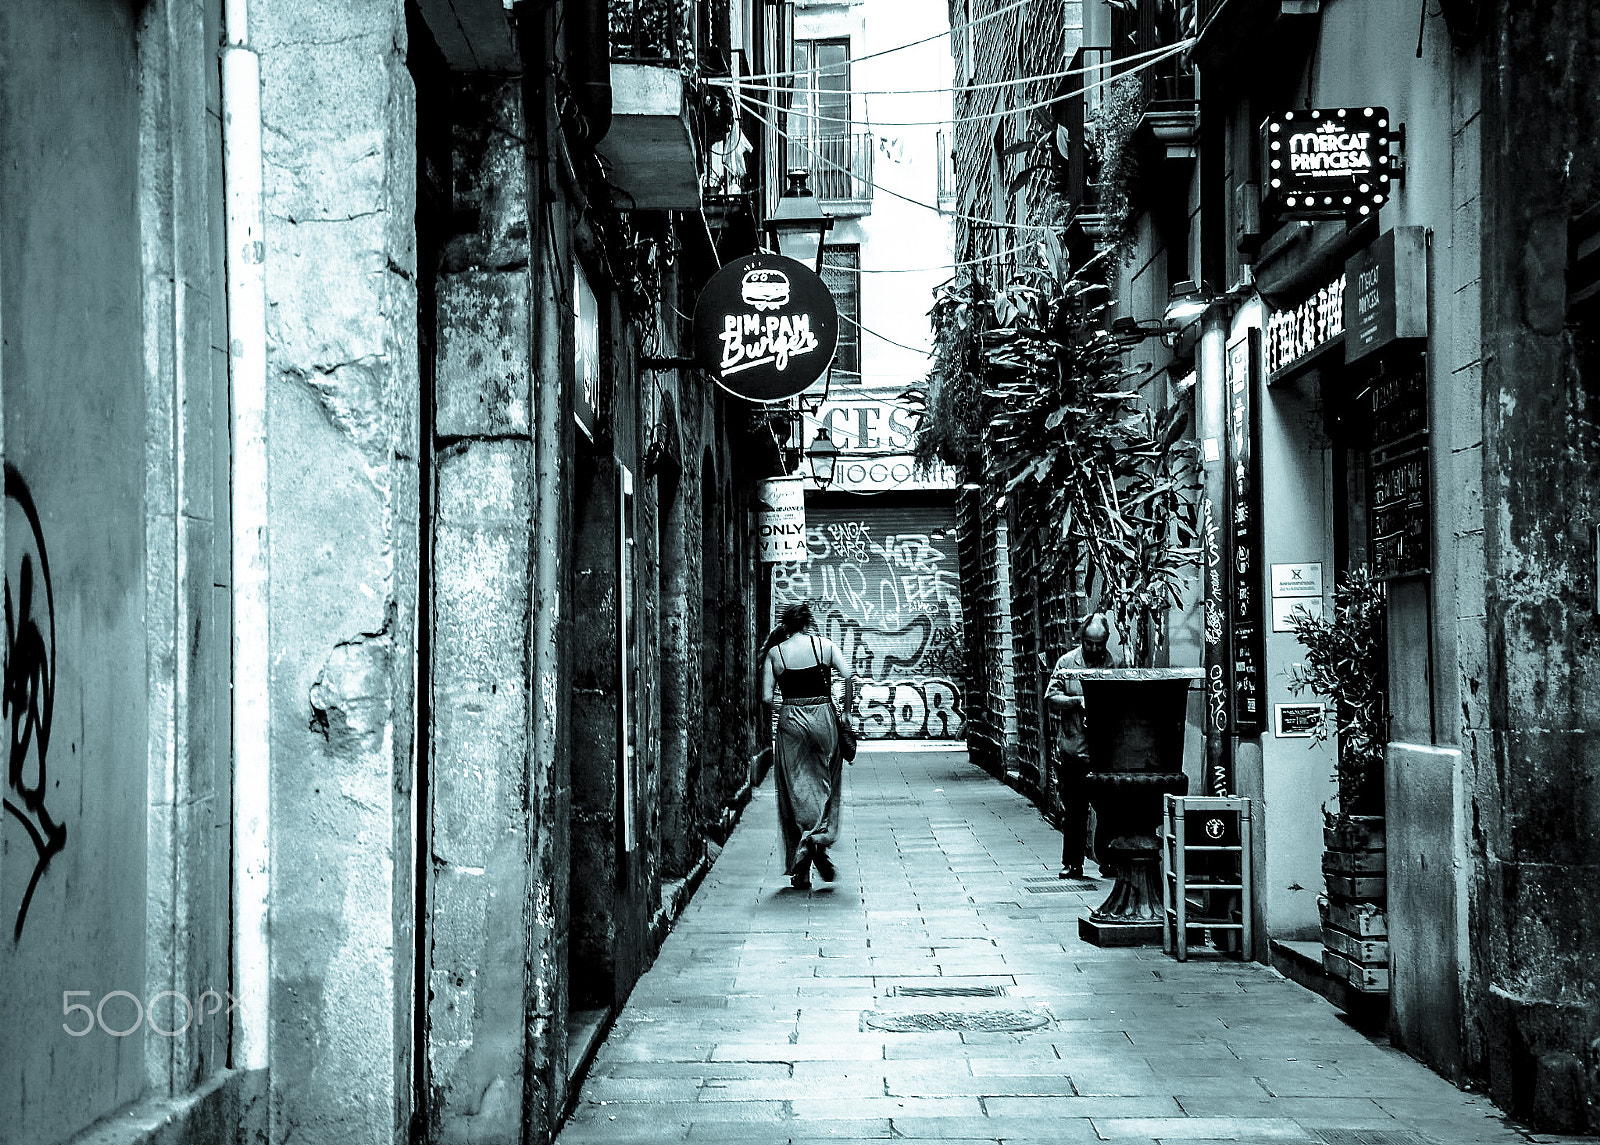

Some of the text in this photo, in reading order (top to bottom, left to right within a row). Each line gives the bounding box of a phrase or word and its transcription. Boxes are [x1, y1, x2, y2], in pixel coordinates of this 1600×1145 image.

[1289, 132, 1371, 154] MERCAT
[1290, 151, 1371, 171] PRINCESA
[719, 330, 819, 371] Burger
[760, 523, 804, 537] ONLY
[760, 540, 806, 552] VILA
